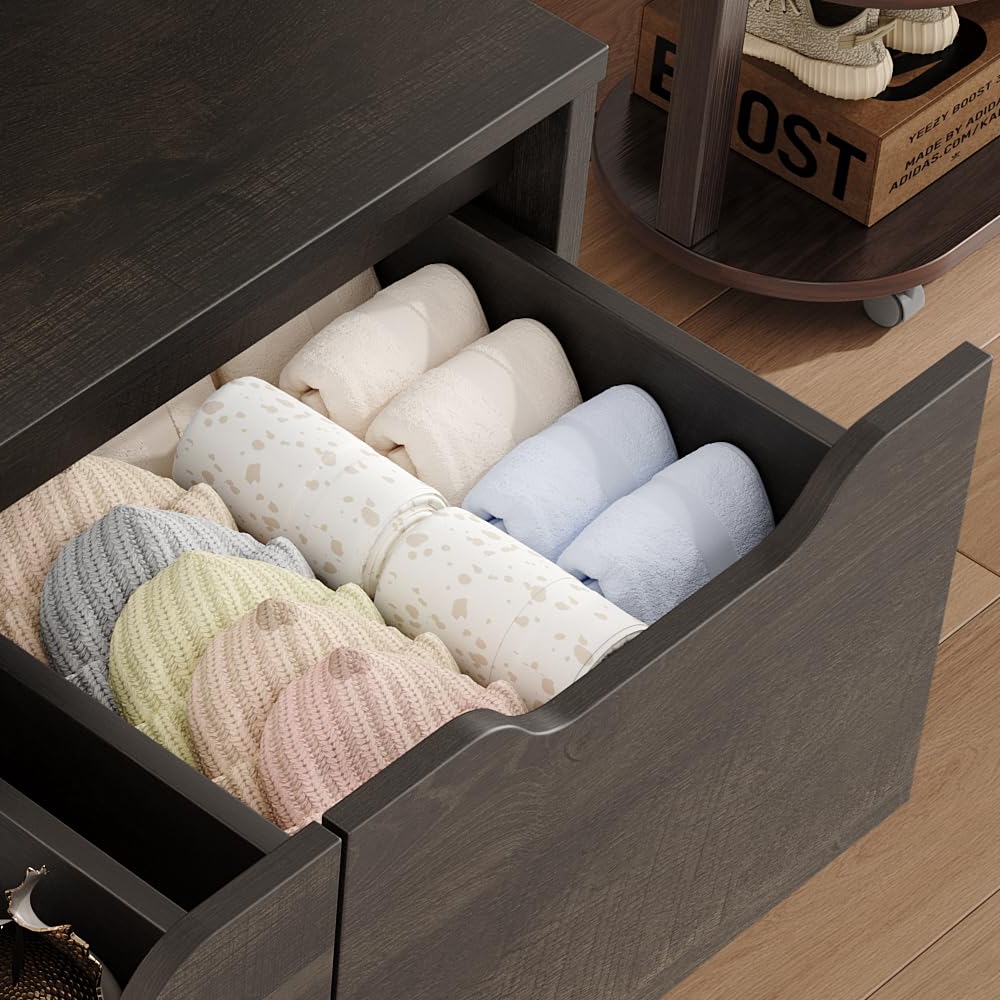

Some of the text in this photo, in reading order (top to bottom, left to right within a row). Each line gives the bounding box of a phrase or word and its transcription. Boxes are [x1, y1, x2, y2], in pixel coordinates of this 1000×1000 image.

[908, 80, 992, 144] YEEZY BOOST
[904, 137, 942, 170] MADE
[945, 124, 963, 142] BY
